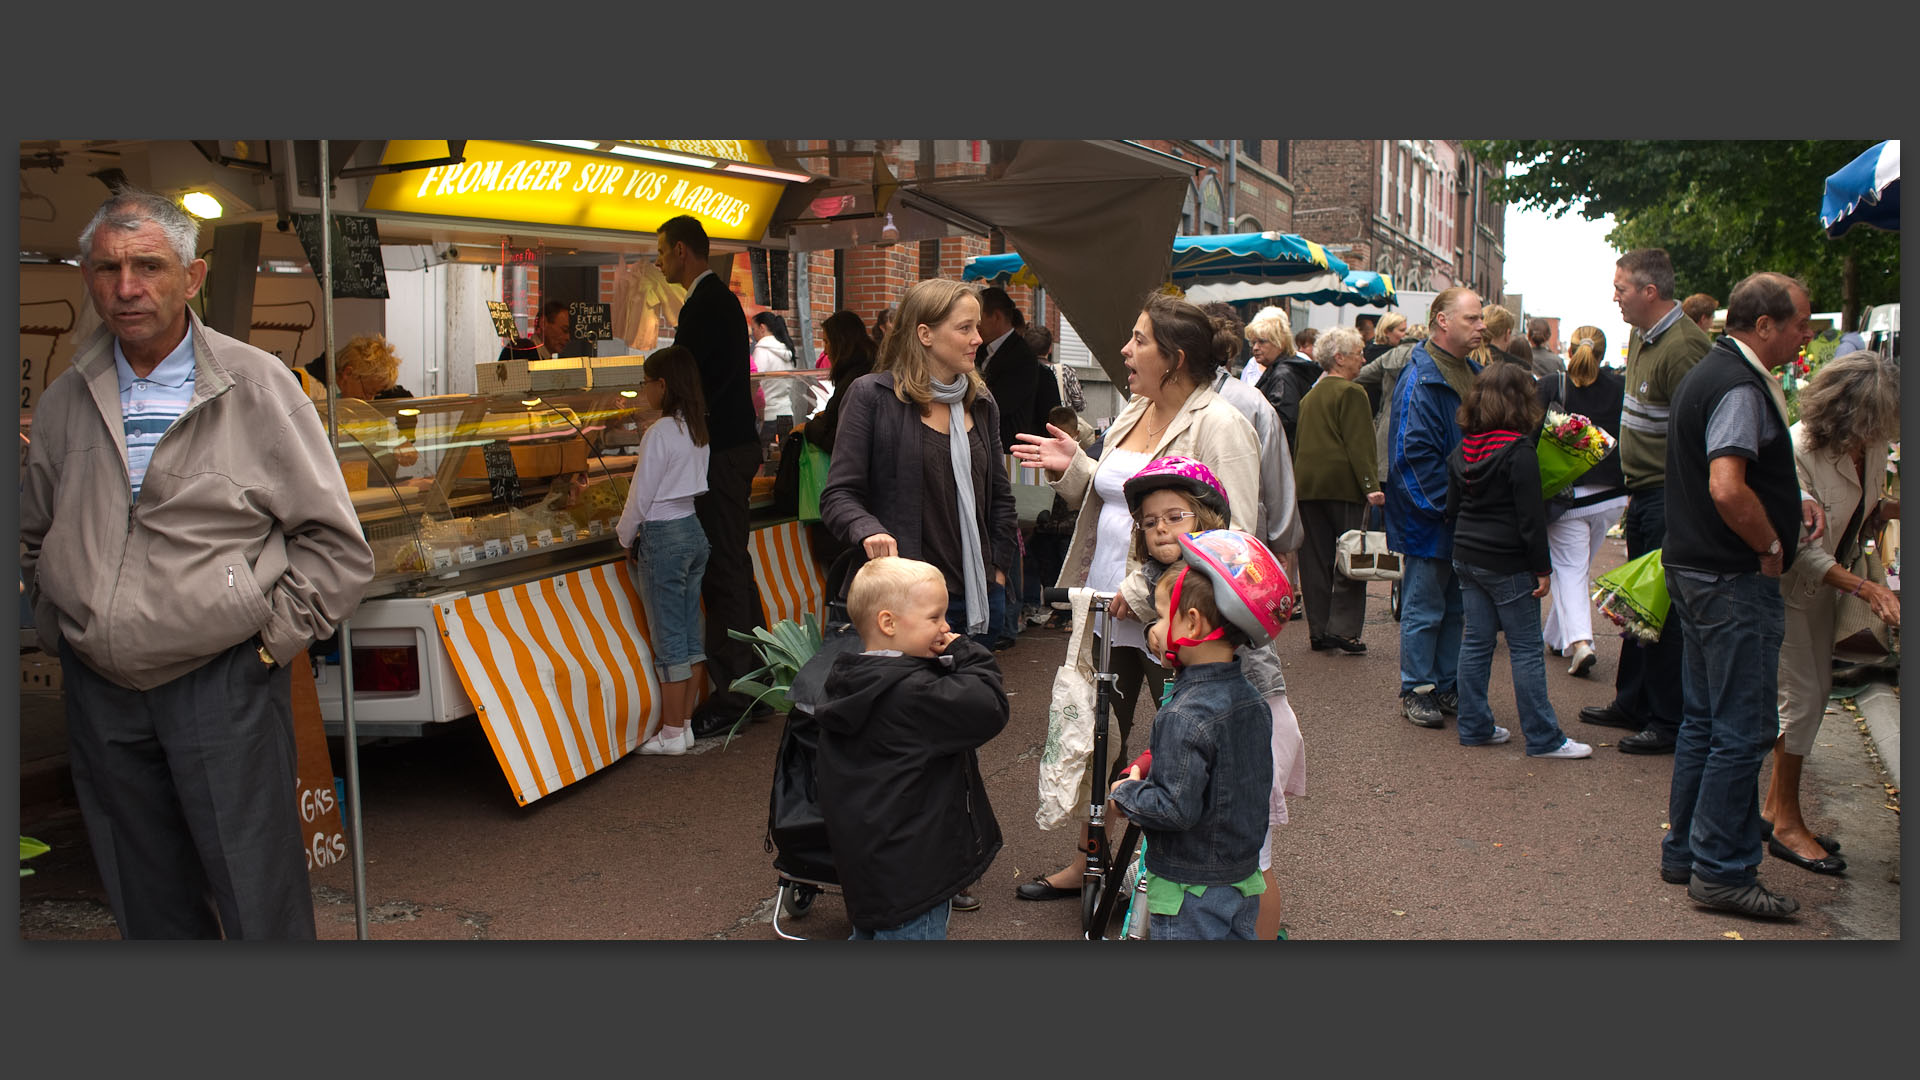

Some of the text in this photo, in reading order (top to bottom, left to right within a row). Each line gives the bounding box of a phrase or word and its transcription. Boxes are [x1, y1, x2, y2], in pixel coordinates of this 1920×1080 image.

[417, 160, 750, 227] FROMAGER SUR VOS MARCHES
[577, 315, 603, 324] EXTRA
[301, 788, 334, 823] GRS
